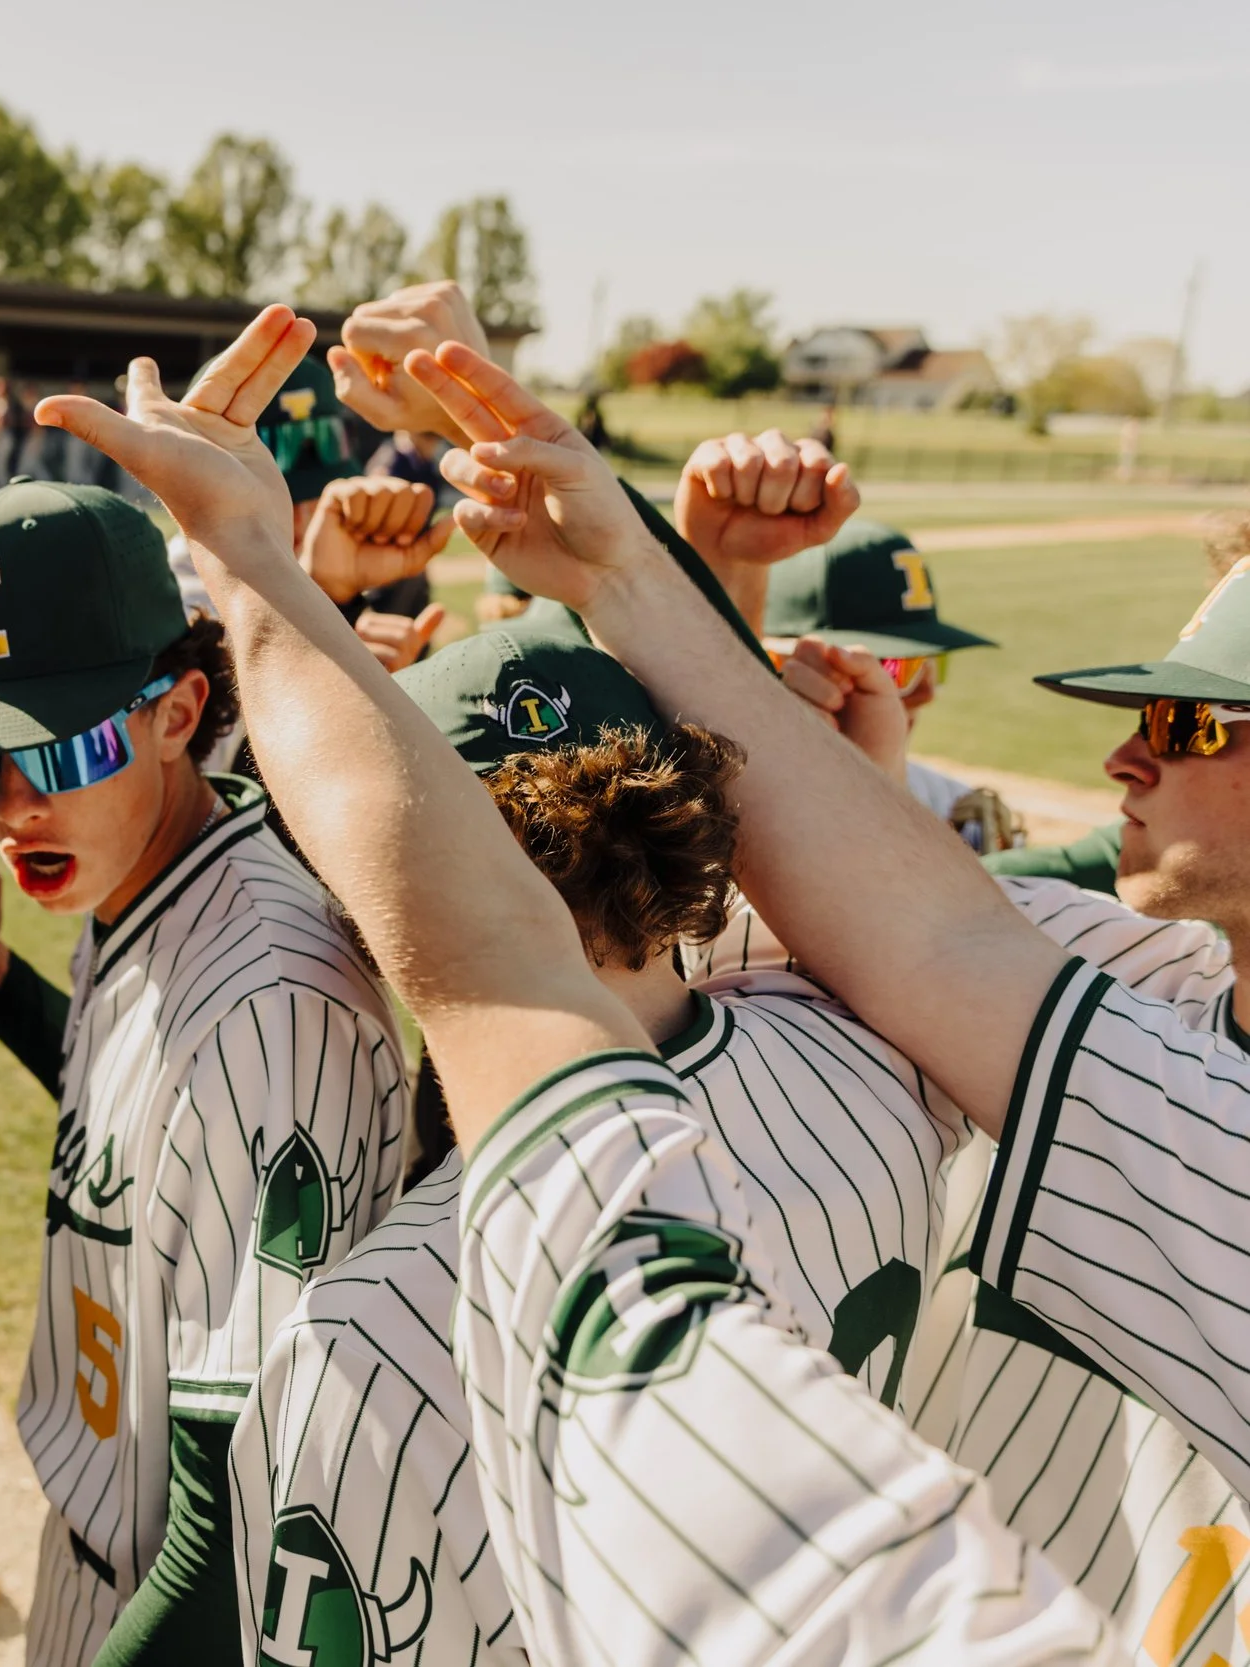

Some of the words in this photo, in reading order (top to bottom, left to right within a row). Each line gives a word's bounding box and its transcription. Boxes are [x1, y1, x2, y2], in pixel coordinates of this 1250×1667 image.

[892, 548, 934, 611] I
[520, 698, 549, 733] I
[72, 1284, 122, 1441] 5
[261, 1545, 330, 1667] I
